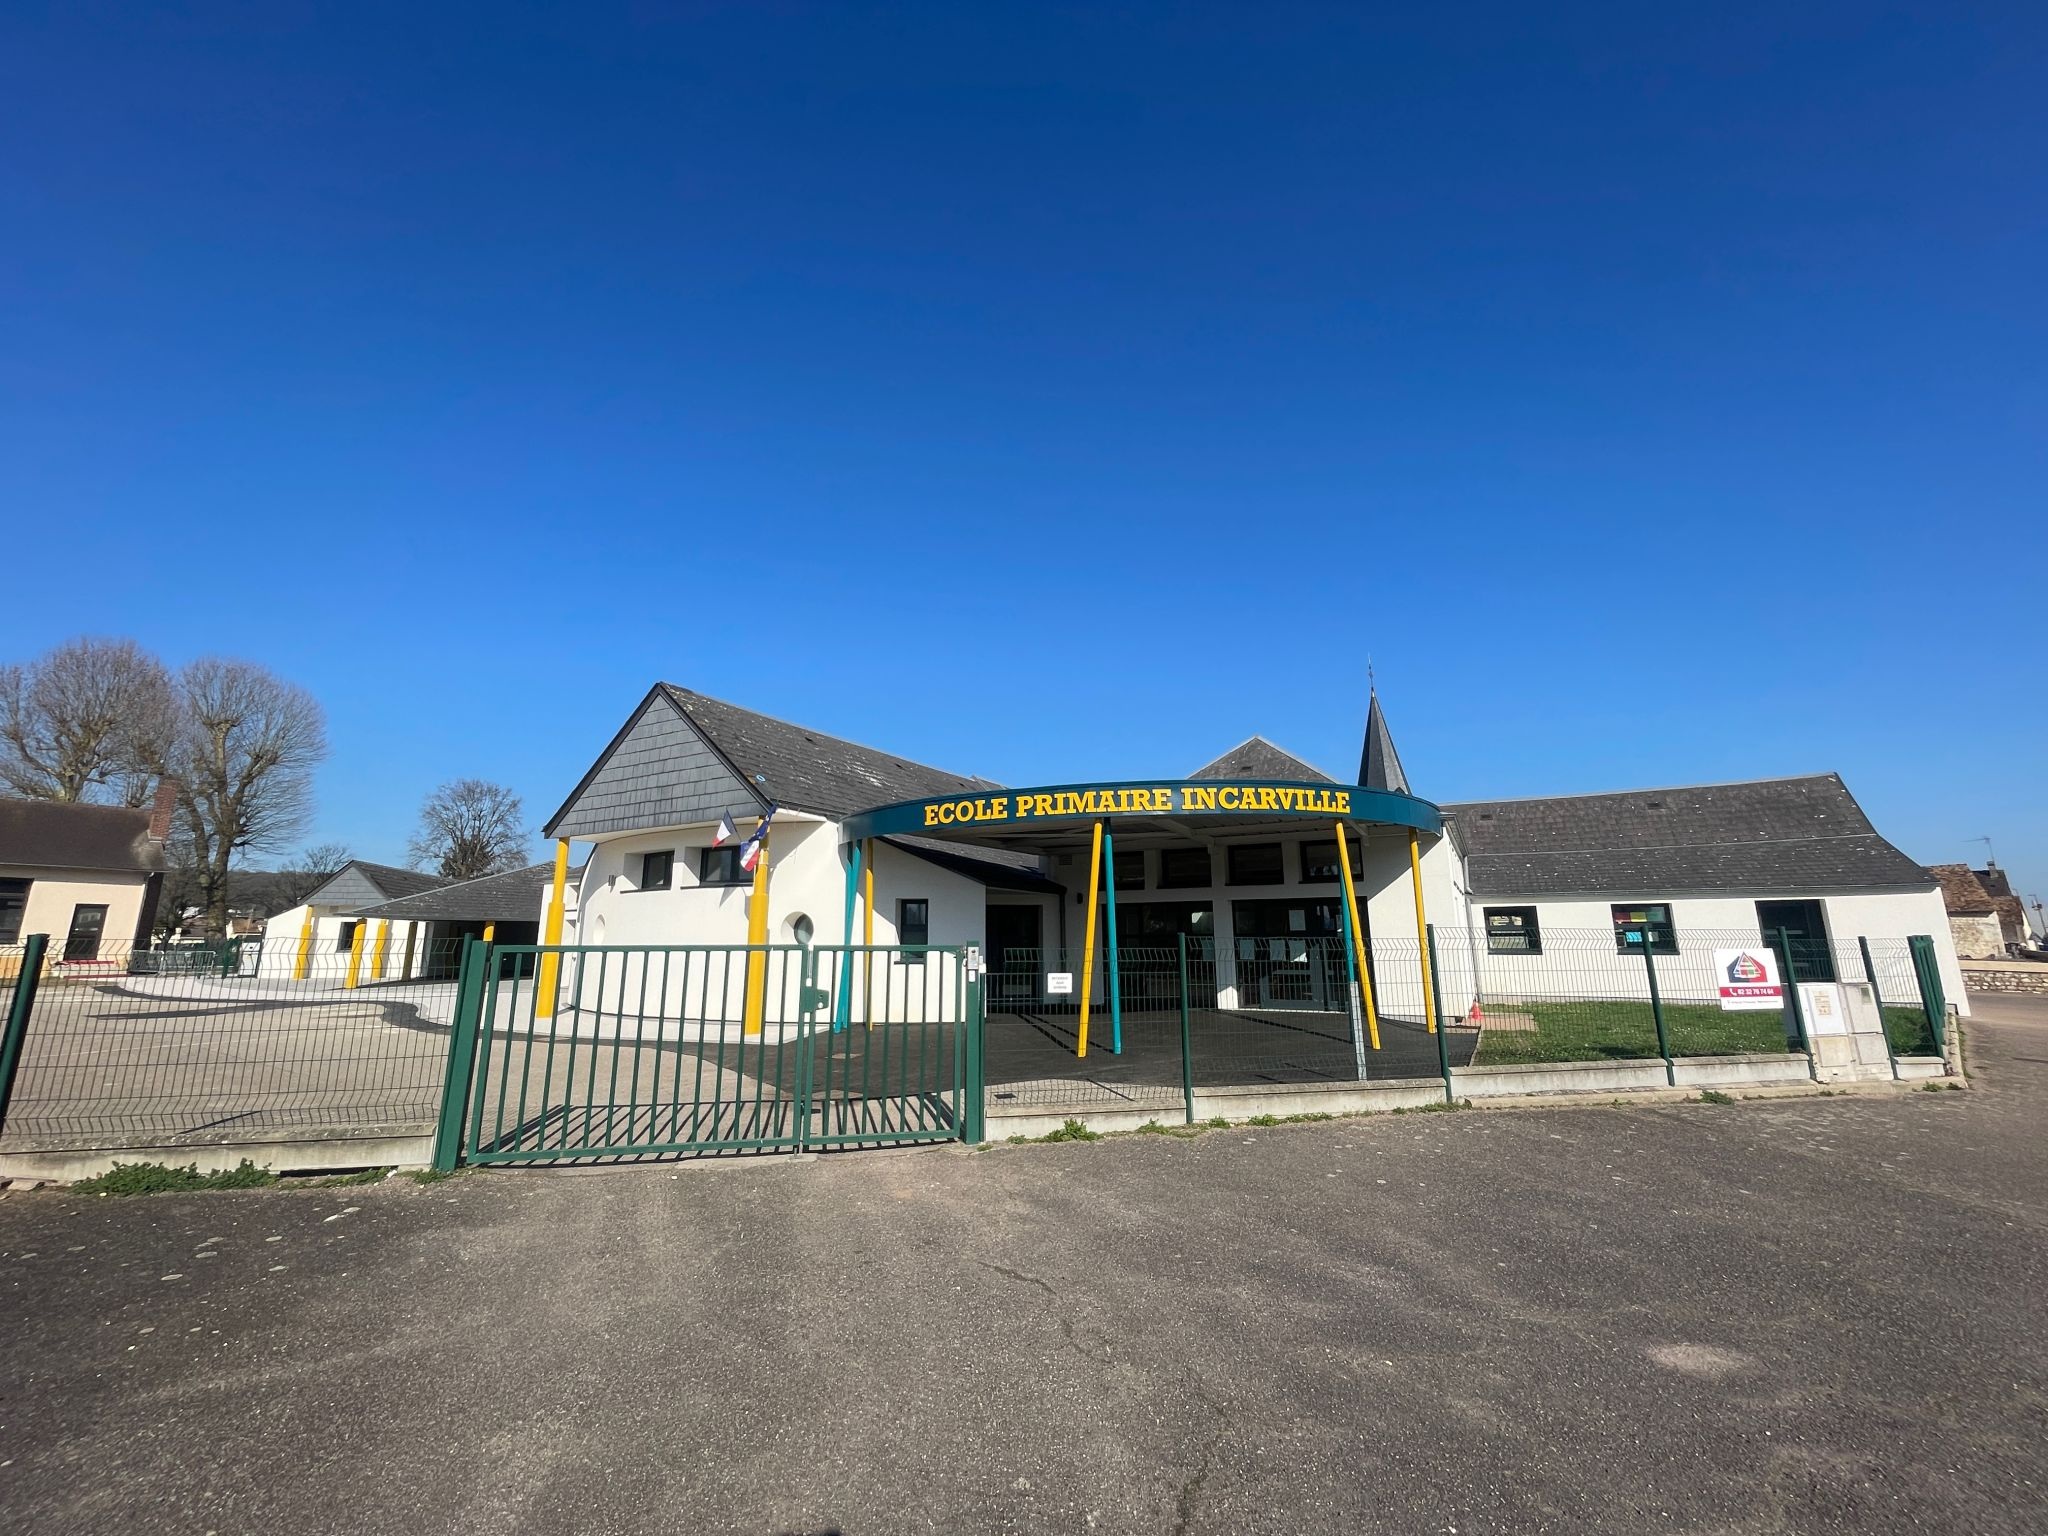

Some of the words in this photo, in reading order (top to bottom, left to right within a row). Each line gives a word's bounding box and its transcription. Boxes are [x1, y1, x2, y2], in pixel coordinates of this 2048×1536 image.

[924, 797, 1009, 826] ECOLE
[1015, 788, 1173, 818] PRIMAIRE
[1180, 787, 1351, 814] INCARVILLE
